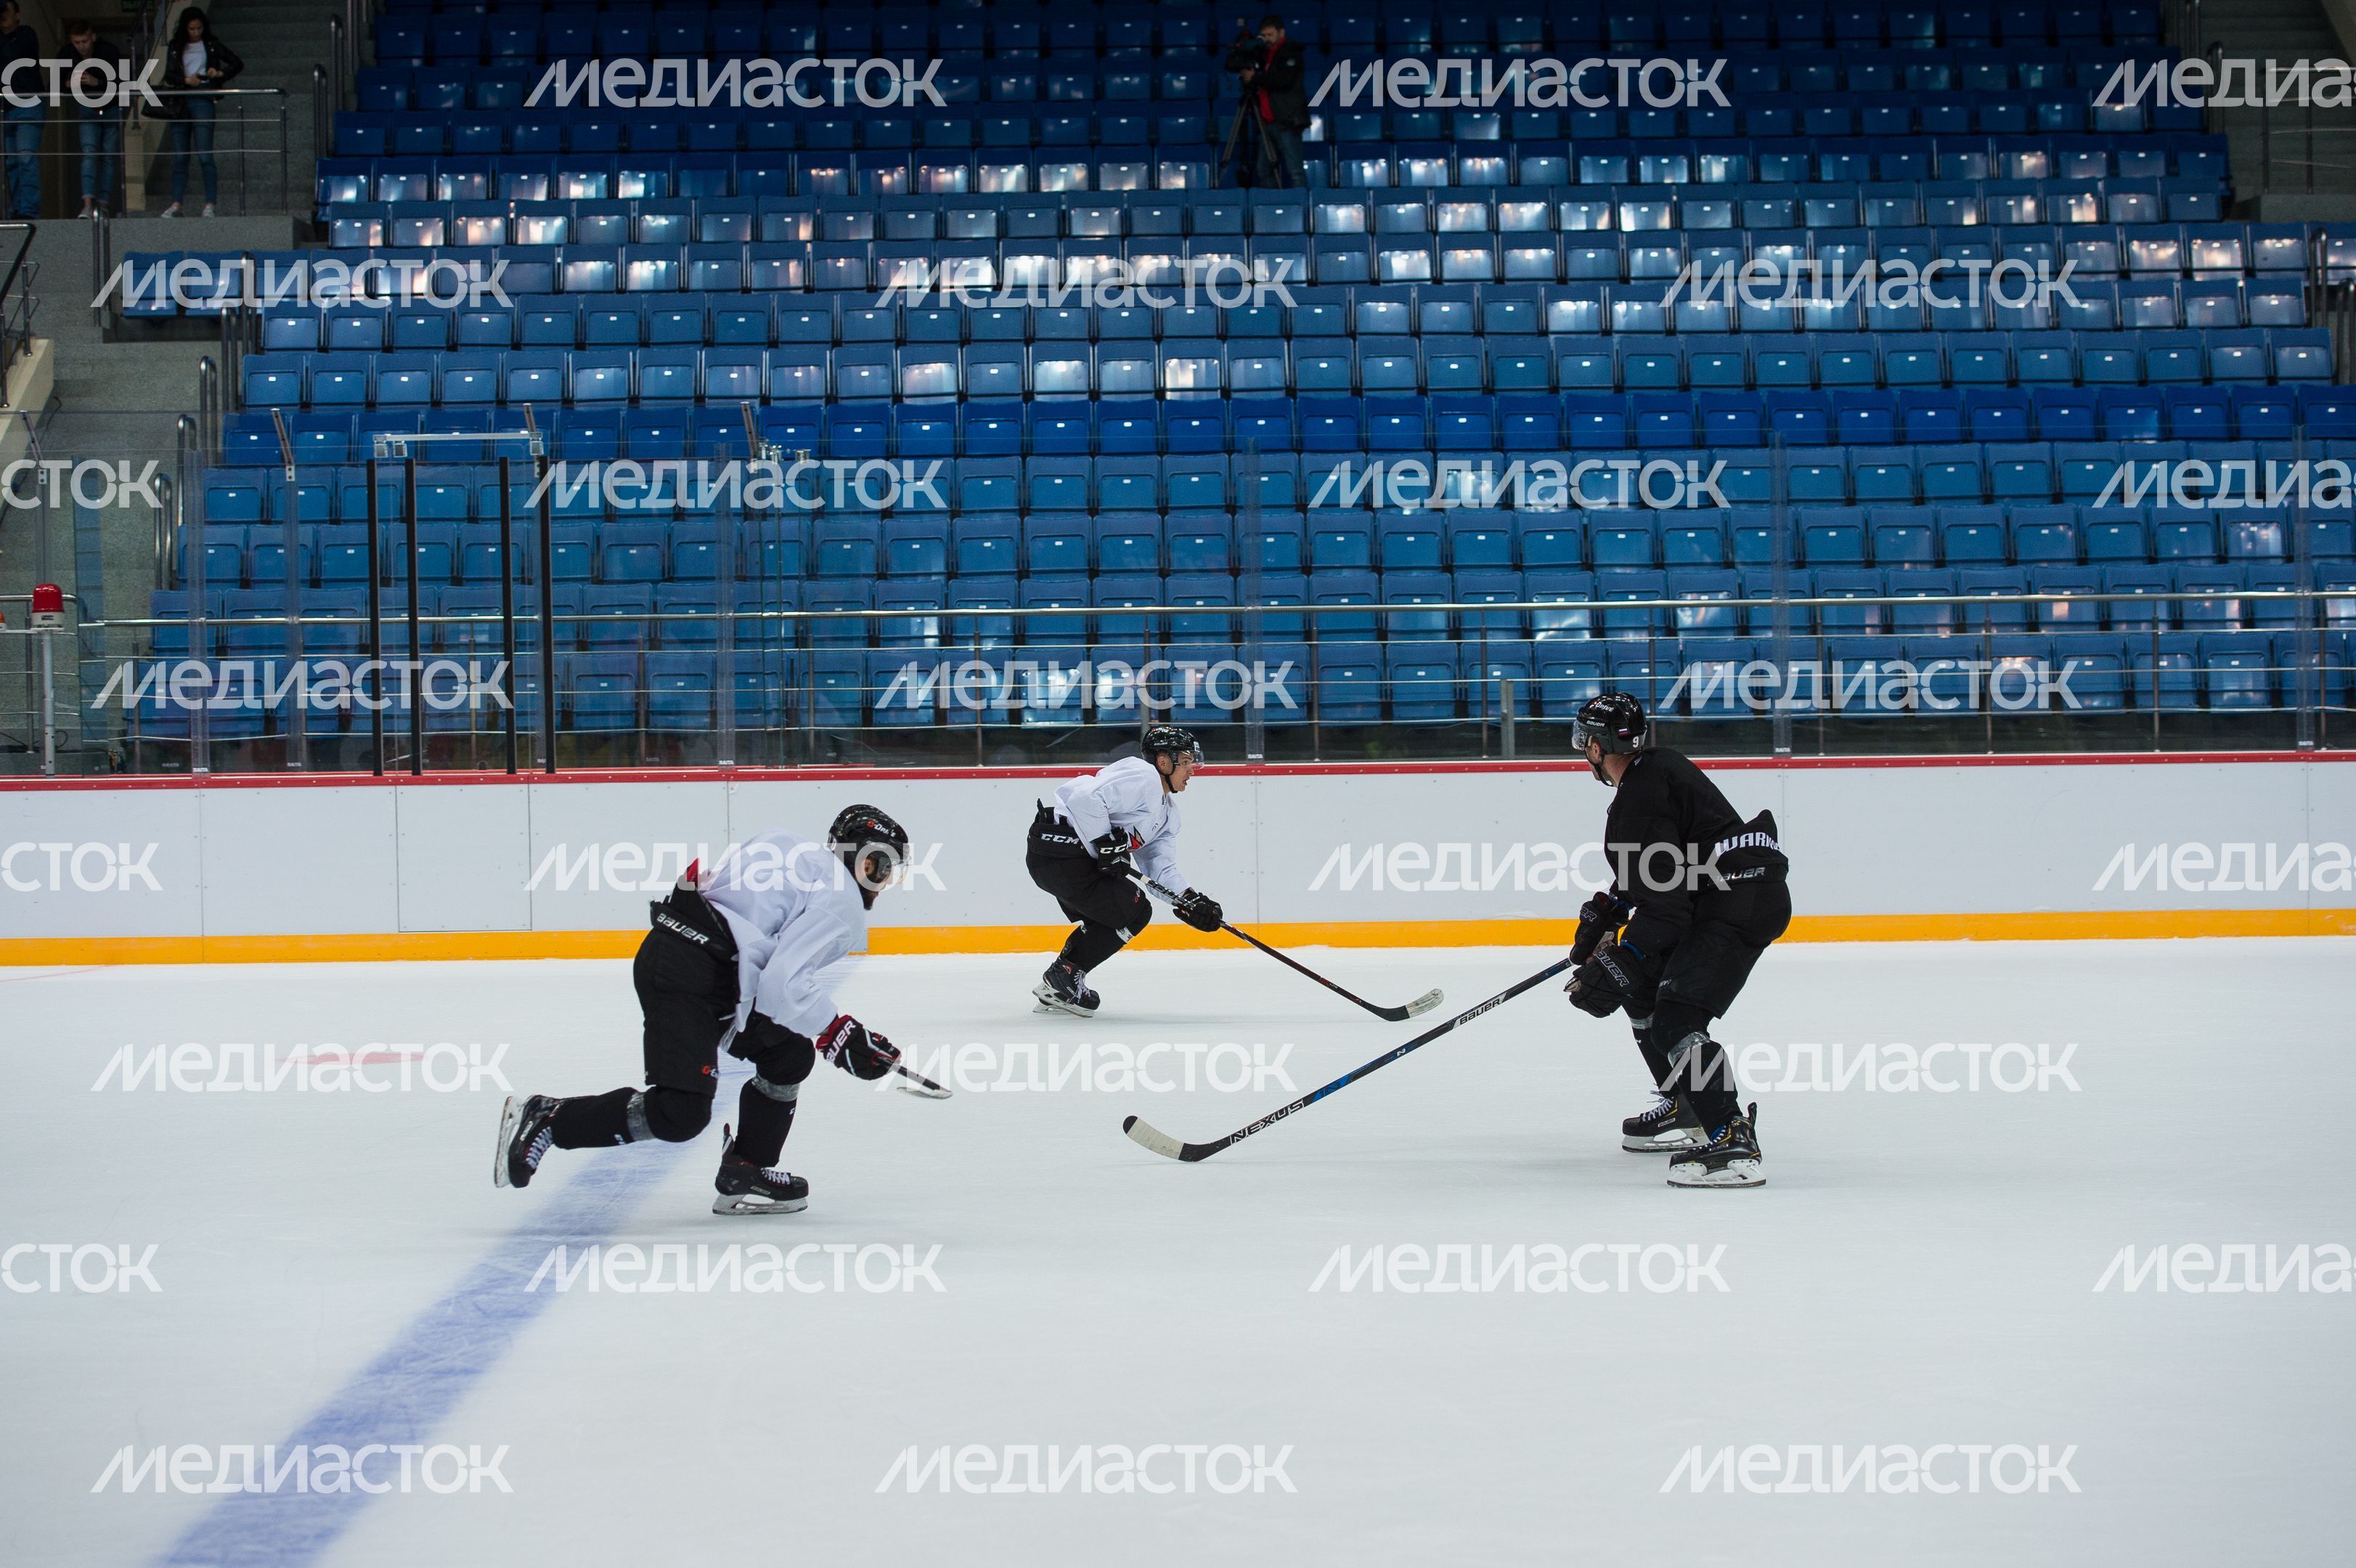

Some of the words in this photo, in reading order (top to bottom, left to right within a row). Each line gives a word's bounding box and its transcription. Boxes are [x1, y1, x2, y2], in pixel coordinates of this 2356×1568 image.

[1631, 735, 1640, 748] 9
[1040, 833, 1080, 844] CCM
[656, 912, 710, 944] BAUER
[1459, 997, 1501, 1026] BAUER
[1229, 1097, 1305, 1146] NEXUS
